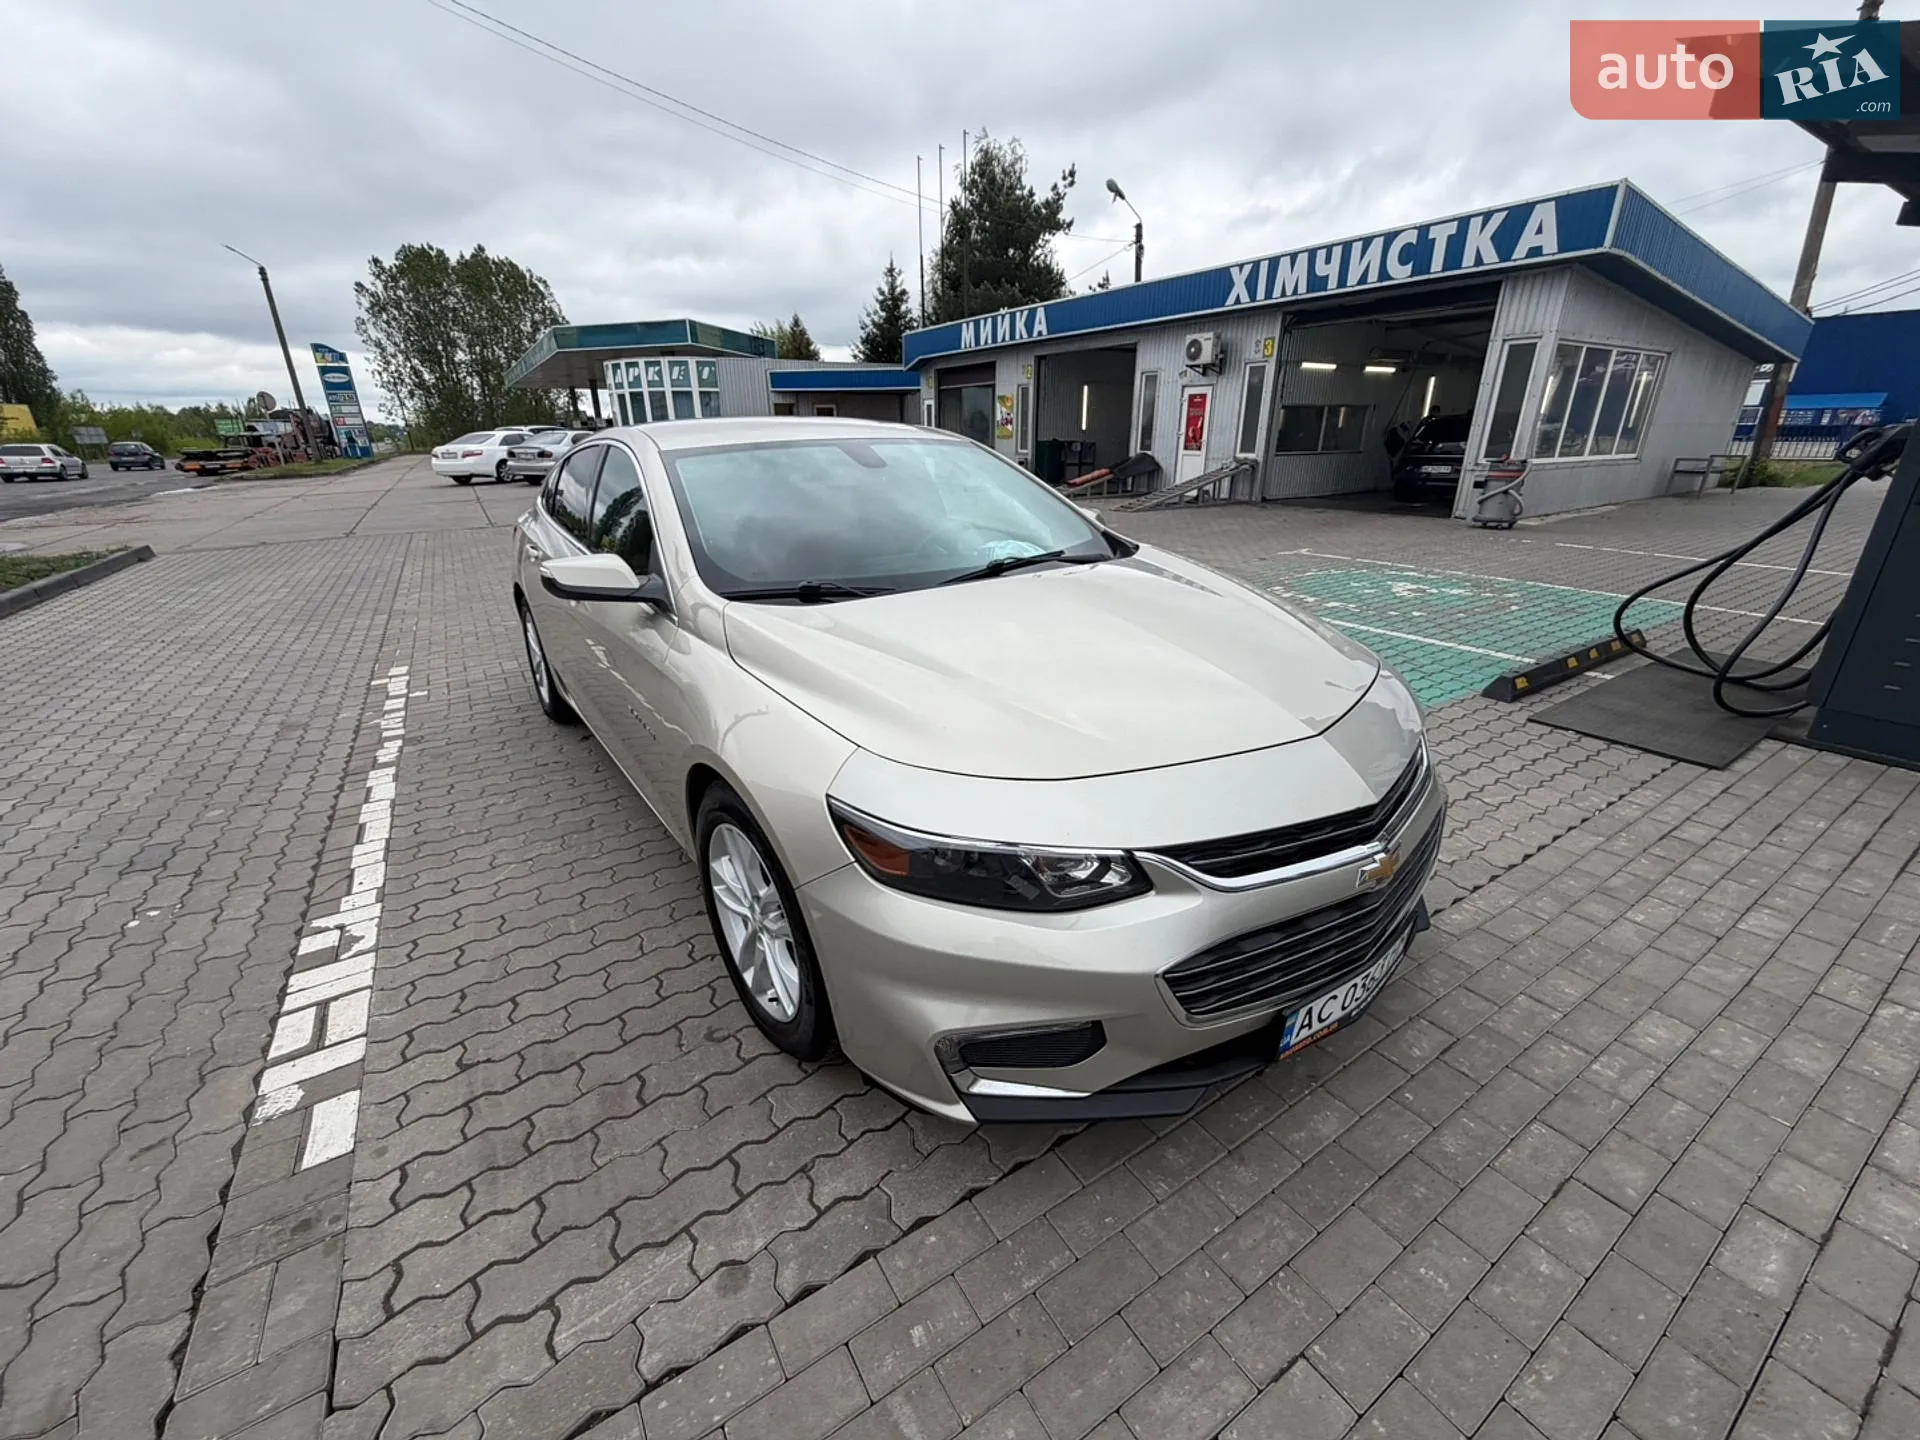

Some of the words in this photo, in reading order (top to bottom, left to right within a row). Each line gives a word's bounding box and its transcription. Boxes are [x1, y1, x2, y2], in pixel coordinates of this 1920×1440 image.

[1224, 200, 1558, 306] ХІМЧИСТКА
[961, 306, 1048, 349] МИЙКА
[1294, 994, 1338, 1039] AC
